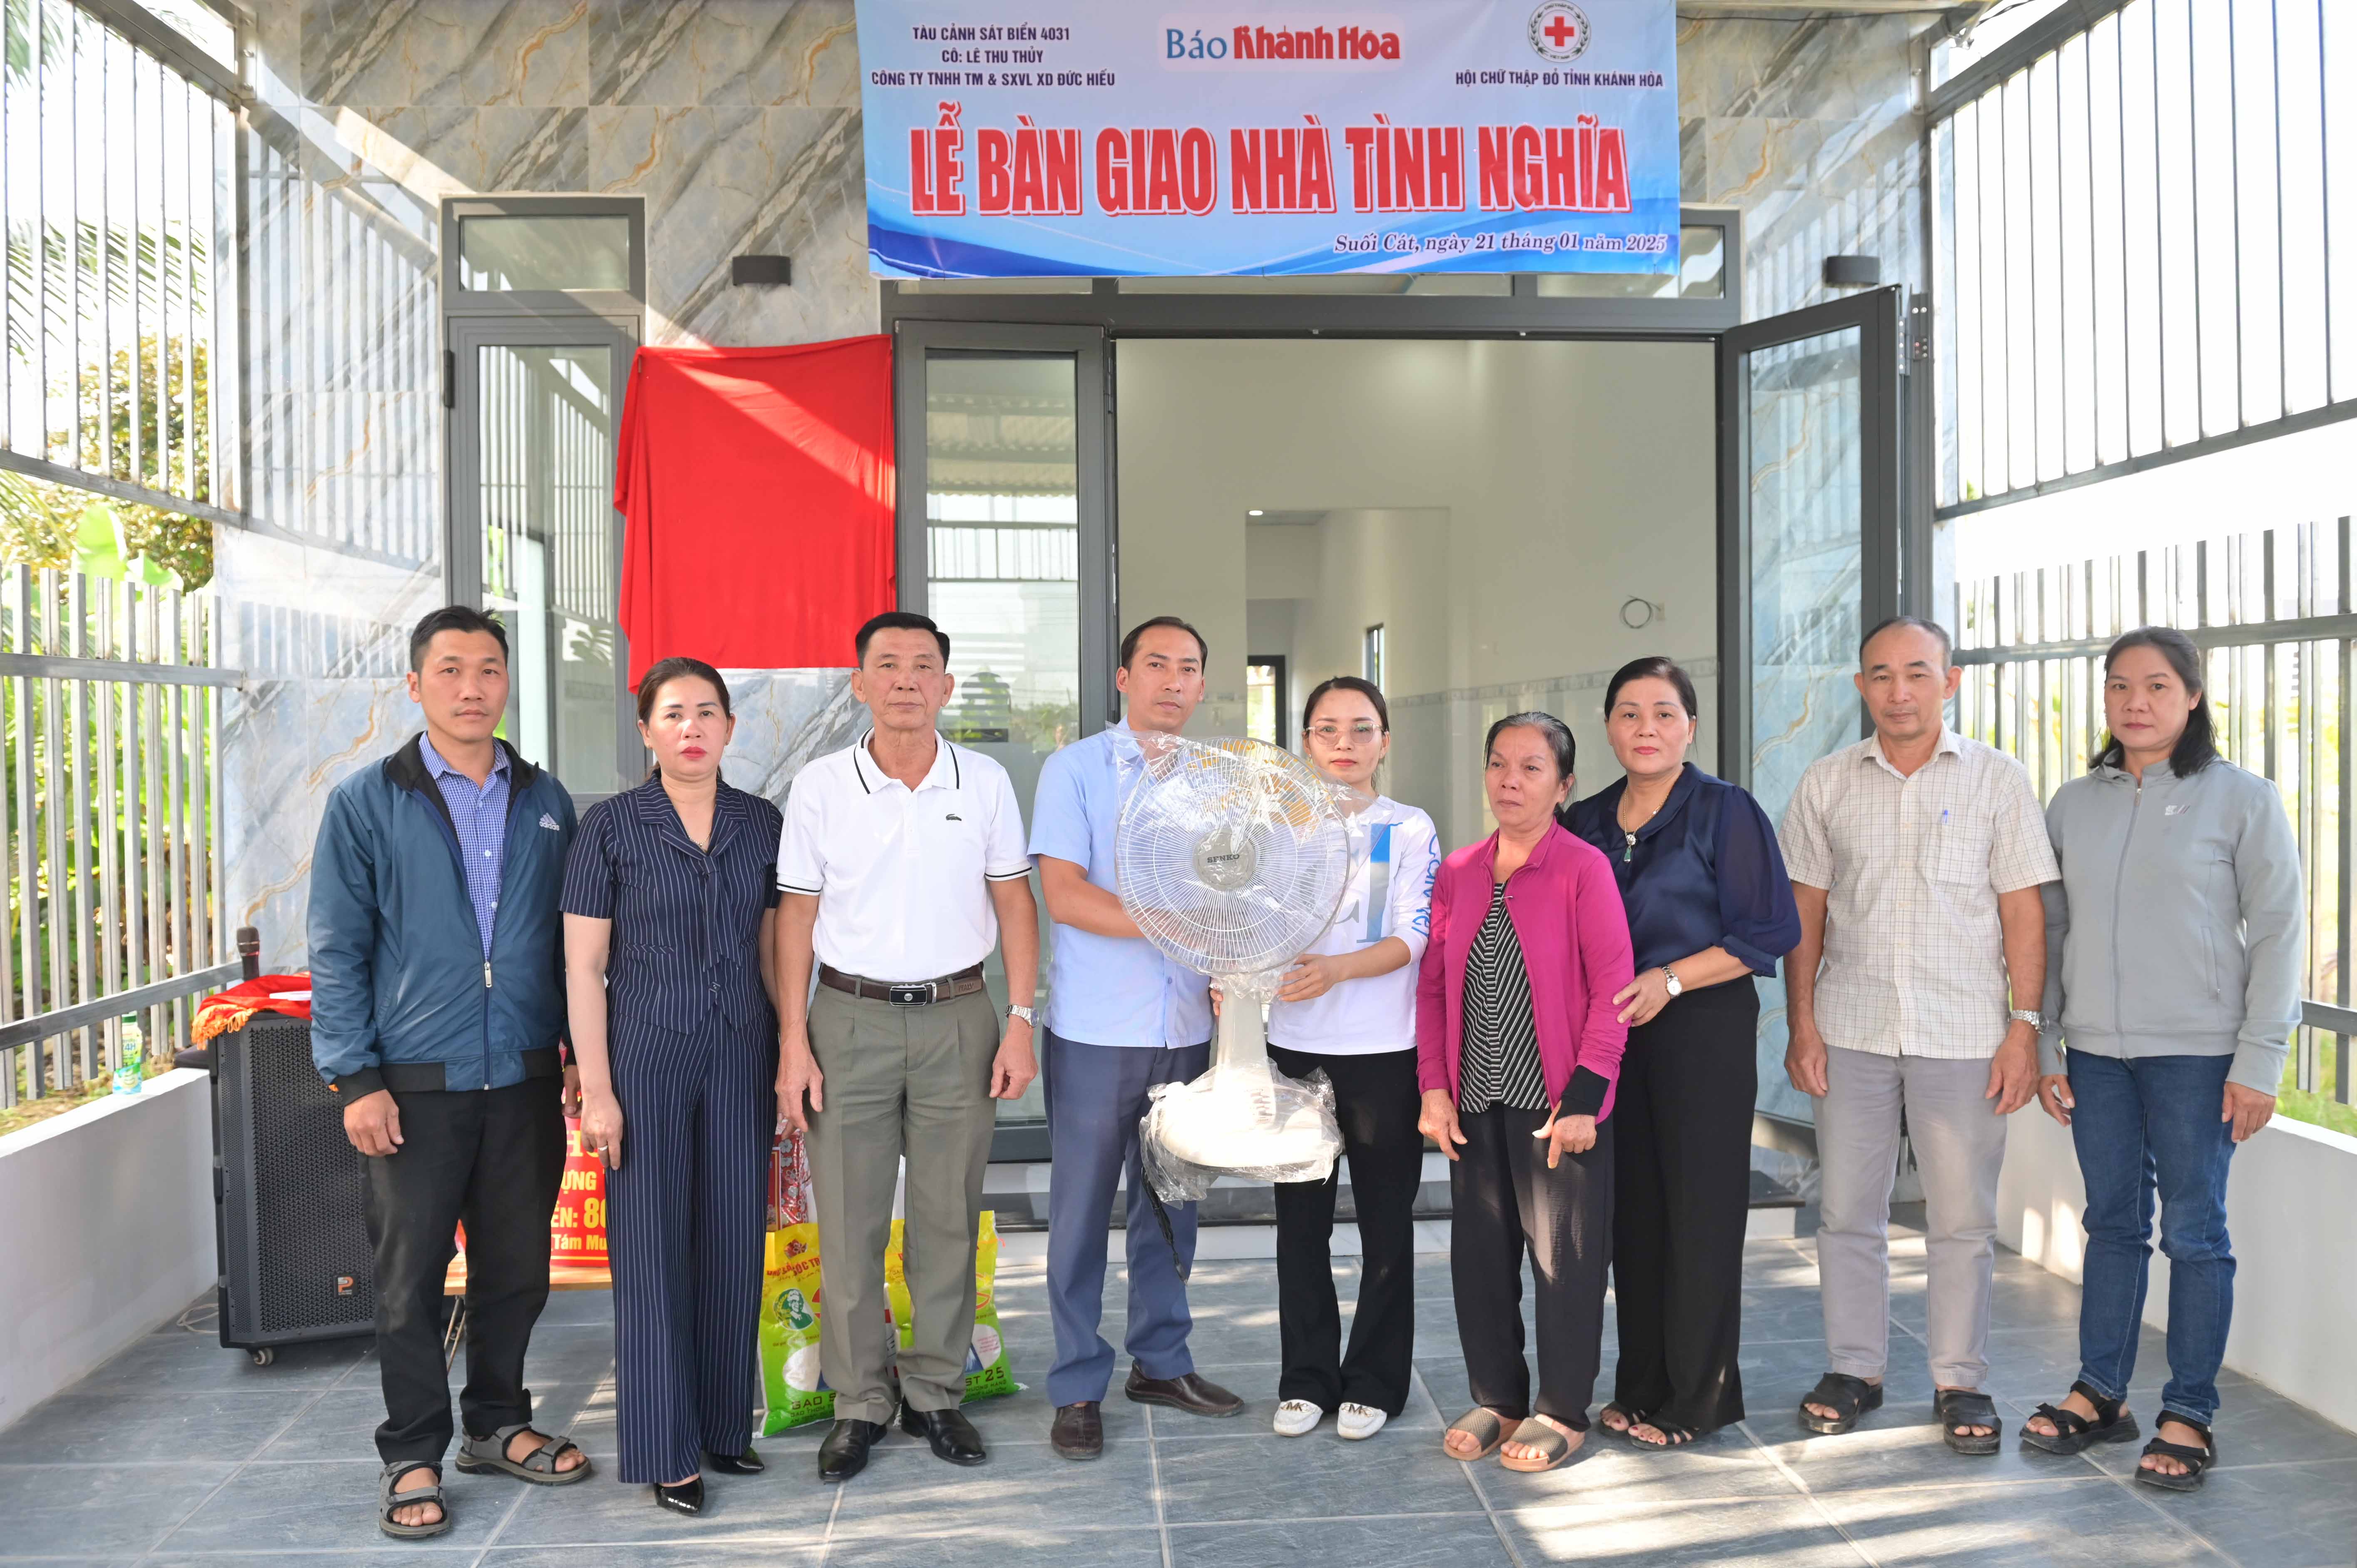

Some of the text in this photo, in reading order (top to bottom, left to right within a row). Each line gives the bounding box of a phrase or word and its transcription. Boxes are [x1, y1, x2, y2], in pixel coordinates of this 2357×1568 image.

[912, 22, 1069, 40] TÀU CẢNH SÁT BIỂN 4031
[1166, 28, 1227, 59] Báo
[1233, 25, 1334, 59] Khánh
[942, 46, 1043, 63] CÔ: LÊ THU THỦY
[872, 68, 1115, 86] CÔNG TY TNHH TM & SXVL XD ĐỨC HIẾU
[1456, 68, 1663, 87] HỘI CHỮ THẬP ĐỎ TỈNH KHÁNH HÒA
[910, 101, 1632, 216] LỄ BÀN GIAO NHÀ TÌNH NGHĨA
[1335, 232, 1665, 253] Suối Cát, ngày 21 tháng 01 năm 2025
[539, 821, 560, 831] adidas
[1207, 854, 1240, 863] SENKO
[561, 1169, 597, 1194] ỰNG
[551, 1234, 582, 1251] Tám
